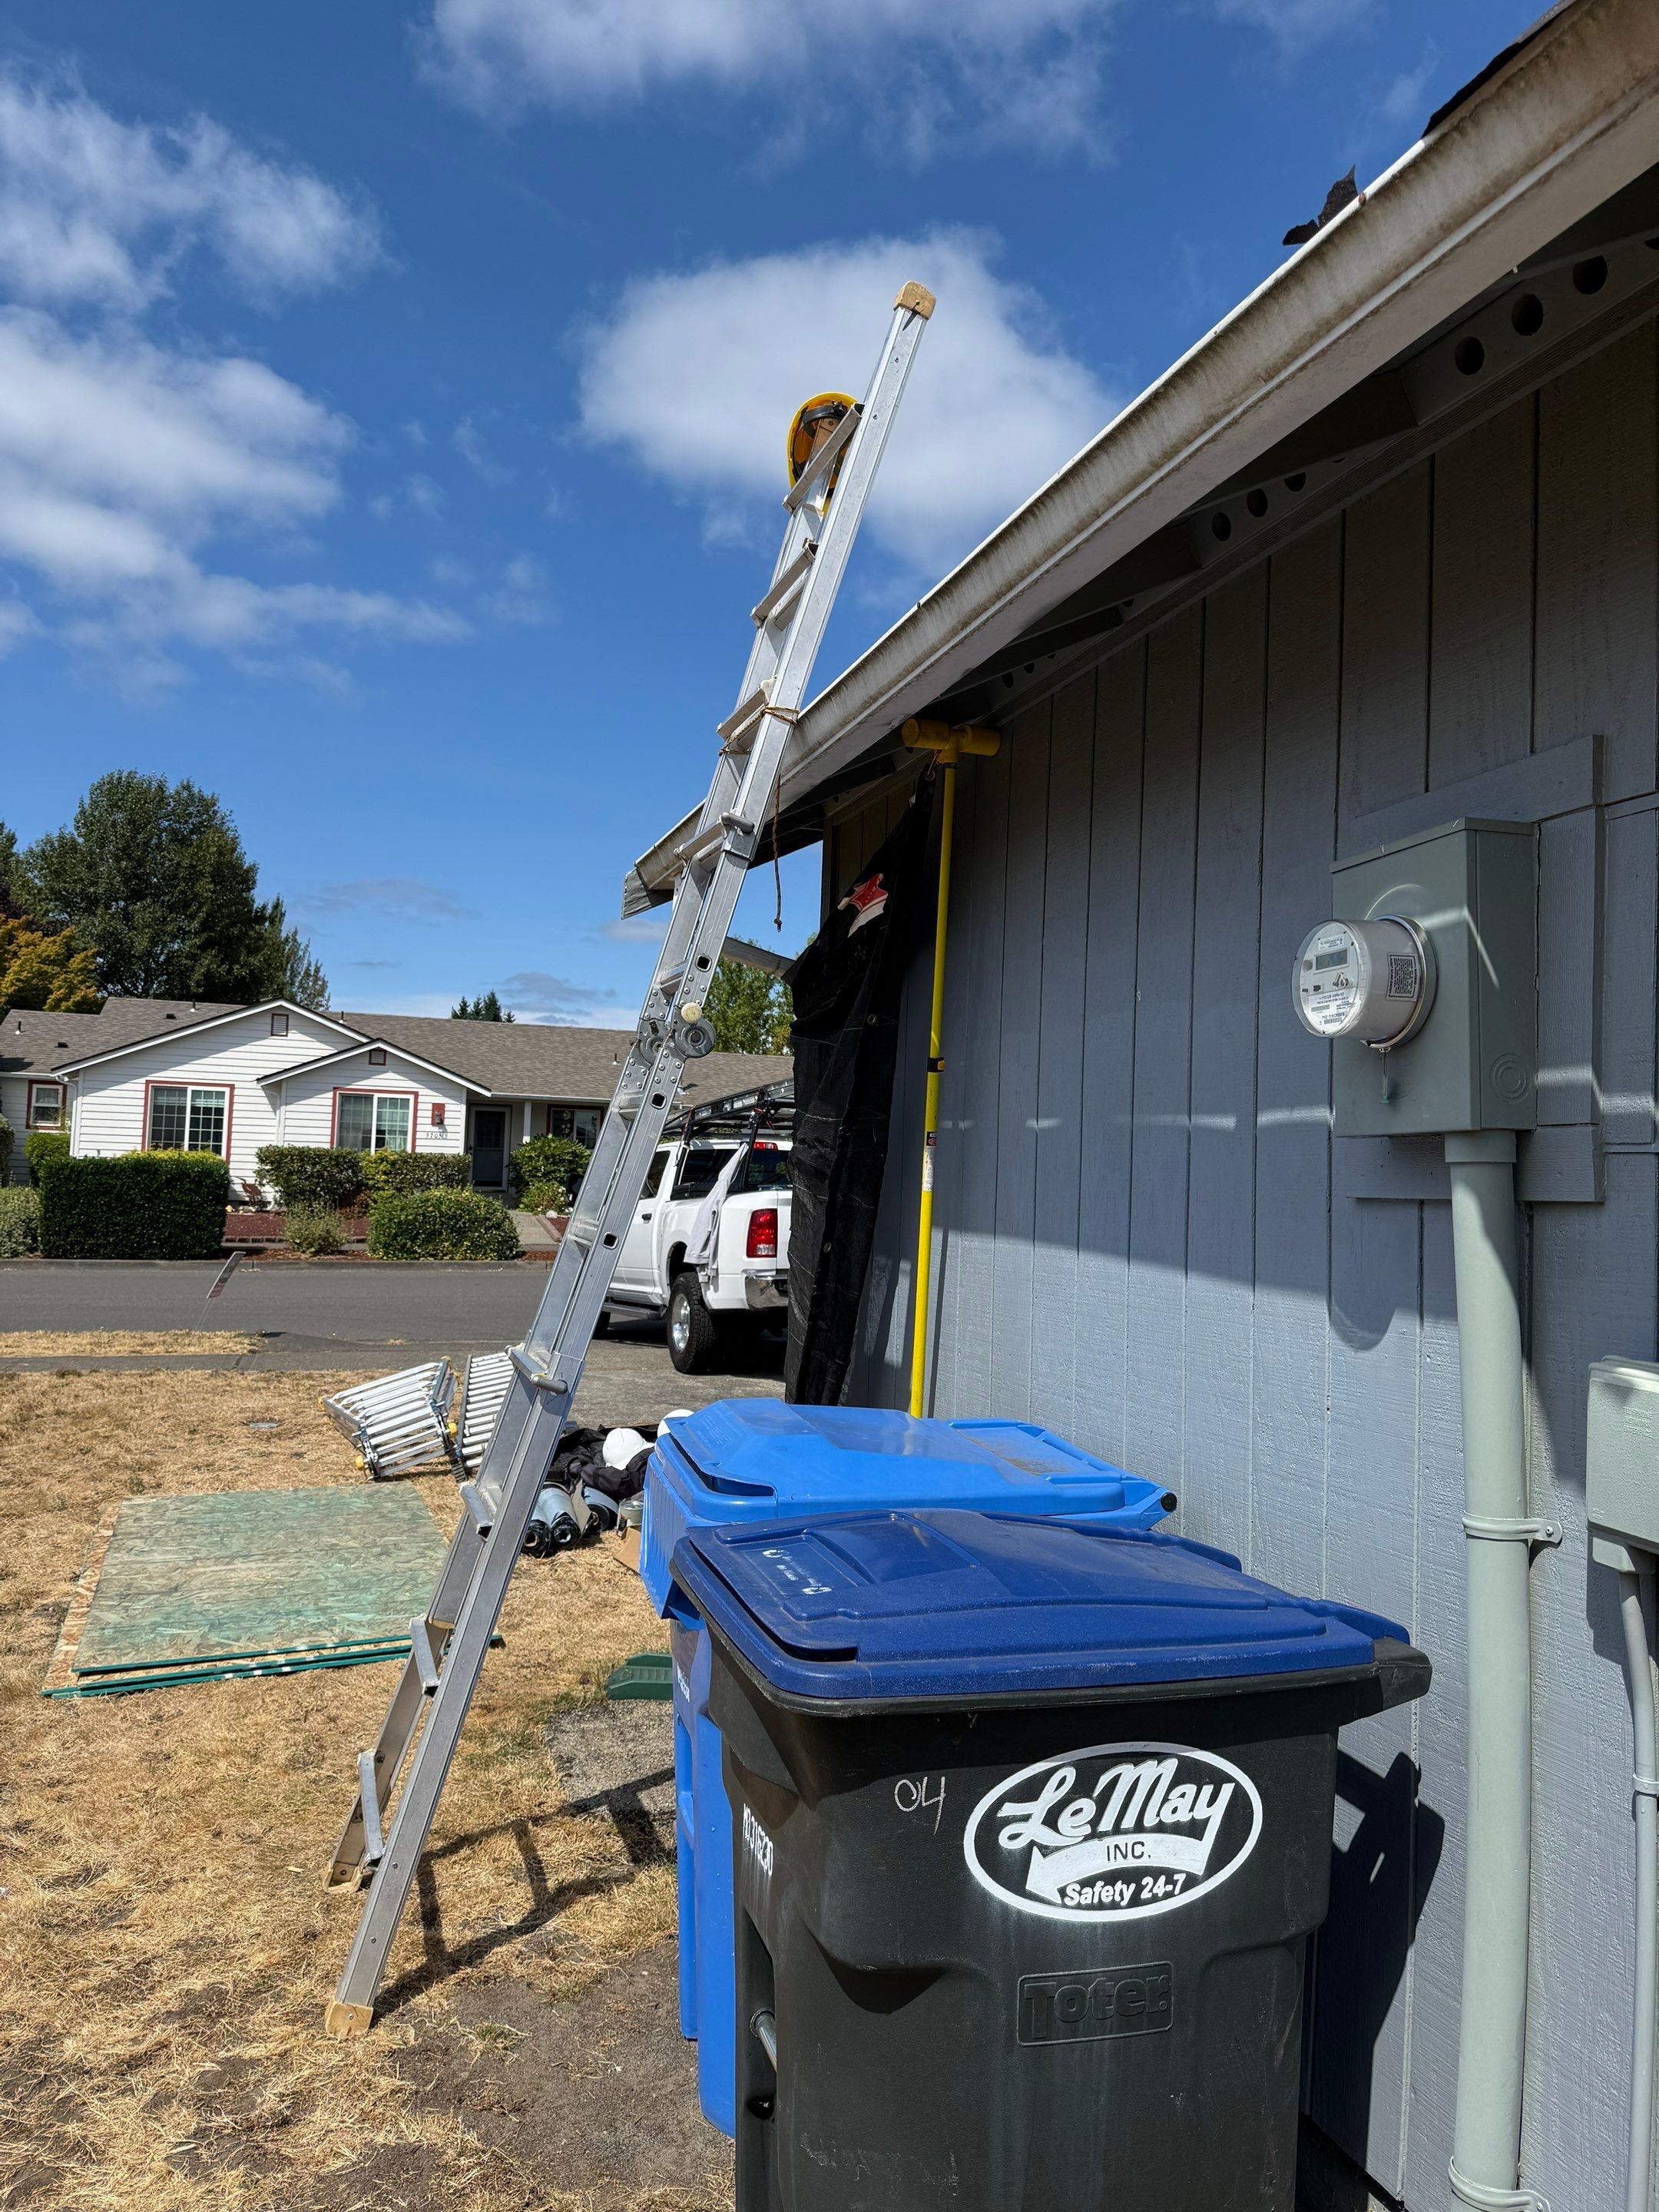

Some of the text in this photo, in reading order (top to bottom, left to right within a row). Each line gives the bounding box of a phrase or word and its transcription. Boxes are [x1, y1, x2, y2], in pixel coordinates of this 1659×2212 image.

[894, 1776, 947, 1835] 04
[997, 1758, 1236, 1853] LeMay
[1107, 1840, 1152, 1863] INC.
[1064, 1873, 1187, 1907] Safety 24-7
[1024, 1975, 1169, 2040] Toter
